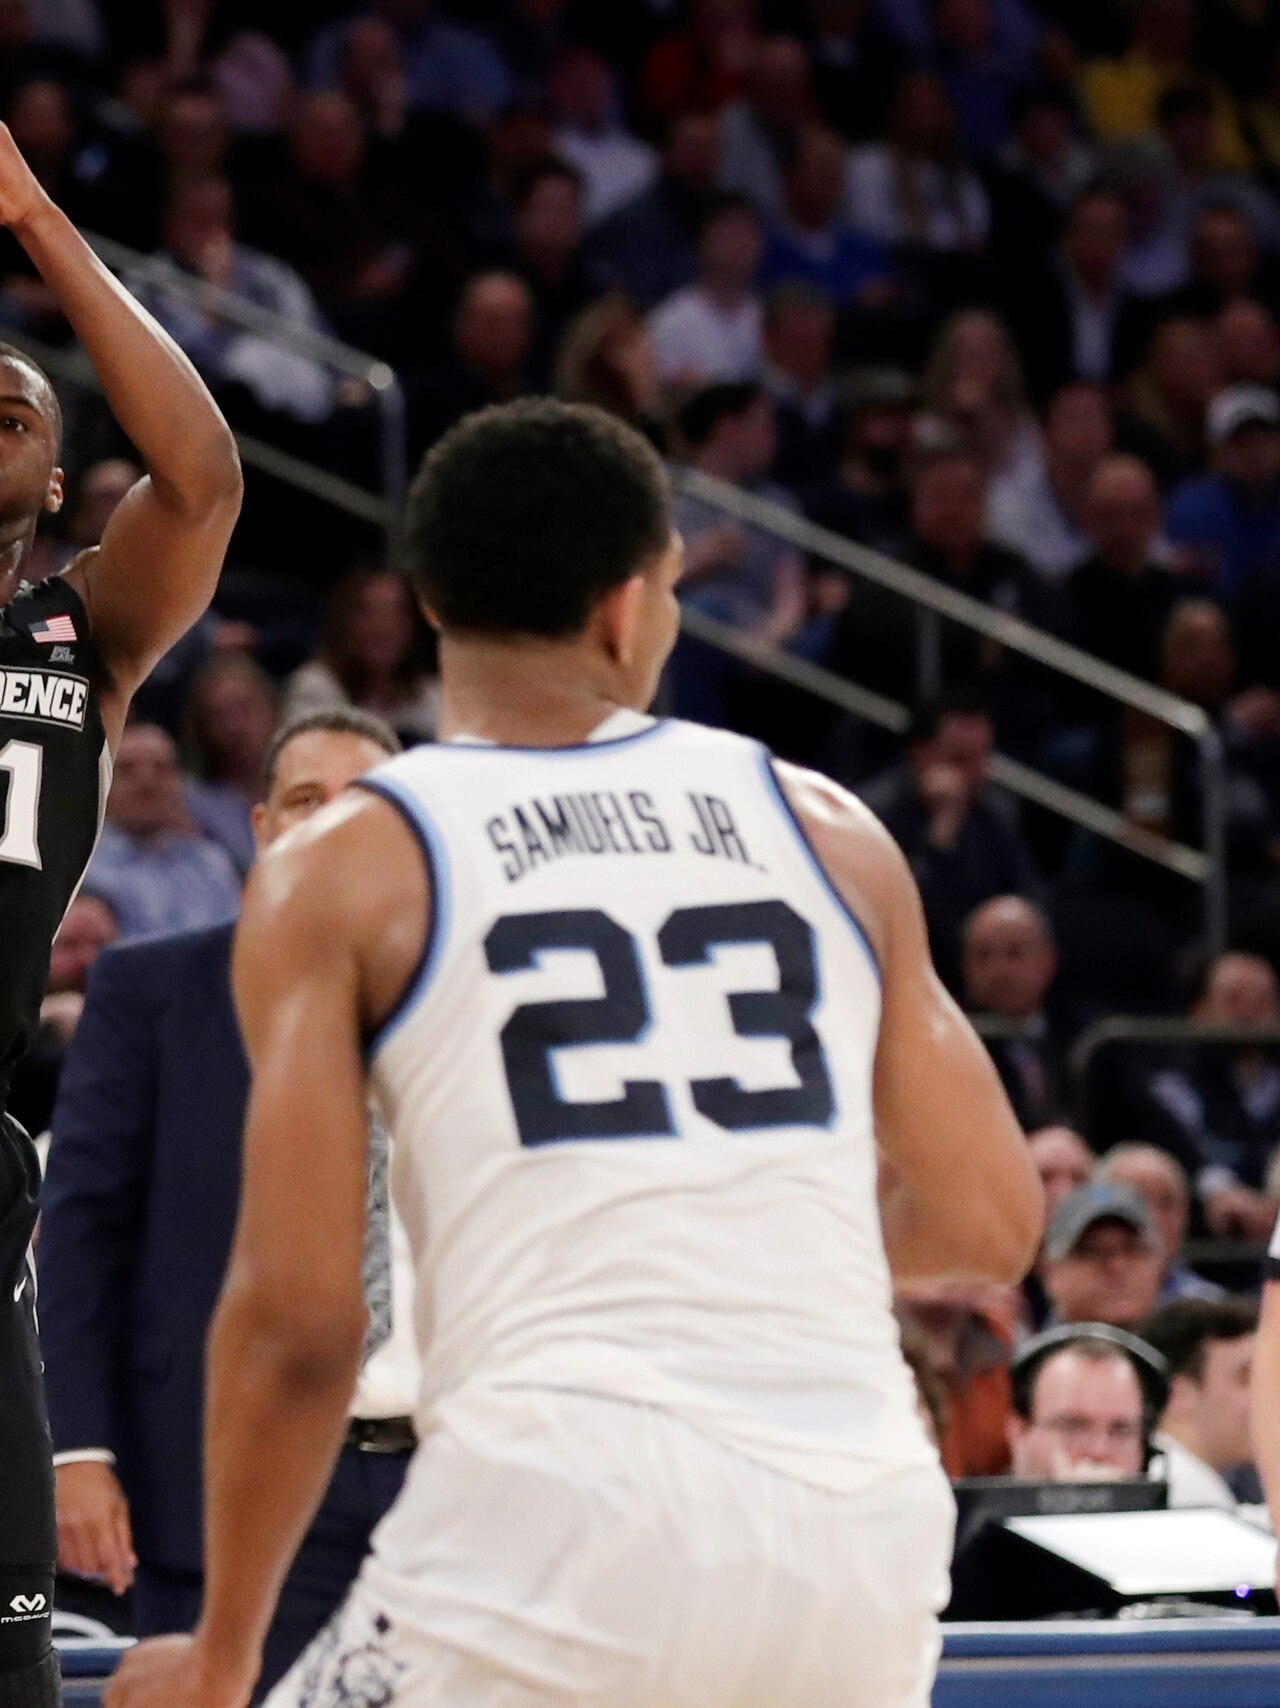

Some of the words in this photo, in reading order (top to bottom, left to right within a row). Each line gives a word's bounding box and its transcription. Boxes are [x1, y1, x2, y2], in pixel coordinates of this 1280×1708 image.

[486, 790, 673, 884] SAMUELS
[686, 790, 768, 873] JR.
[483, 899, 837, 1149] 23
